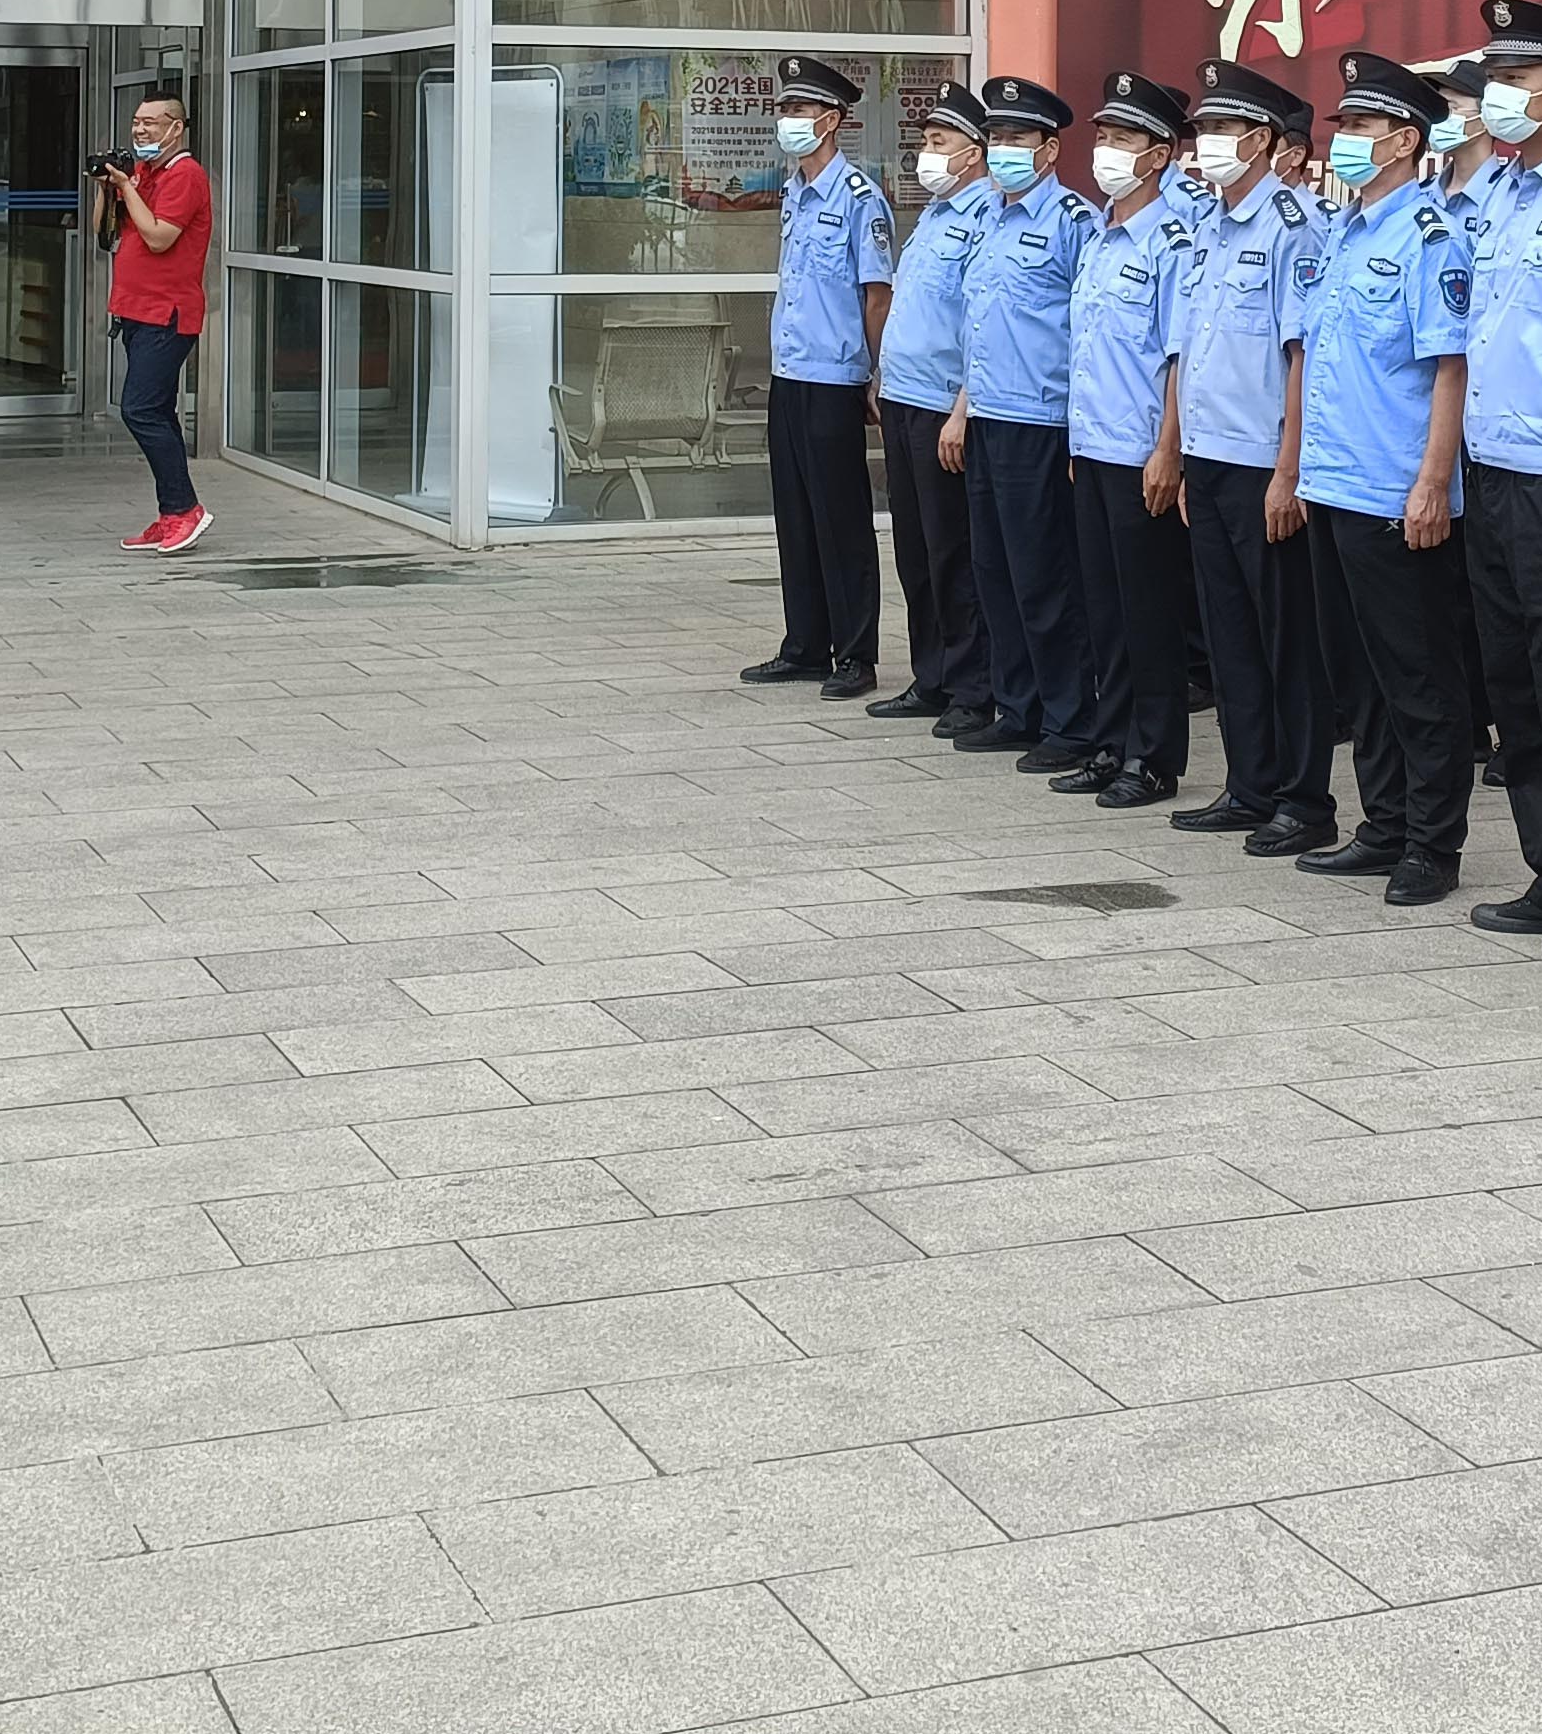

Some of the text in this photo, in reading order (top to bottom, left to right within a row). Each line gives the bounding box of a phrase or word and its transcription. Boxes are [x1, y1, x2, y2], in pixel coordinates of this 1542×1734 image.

[692, 76, 773, 95] 2021全国
[691, 97, 775, 116] 安全生产月
